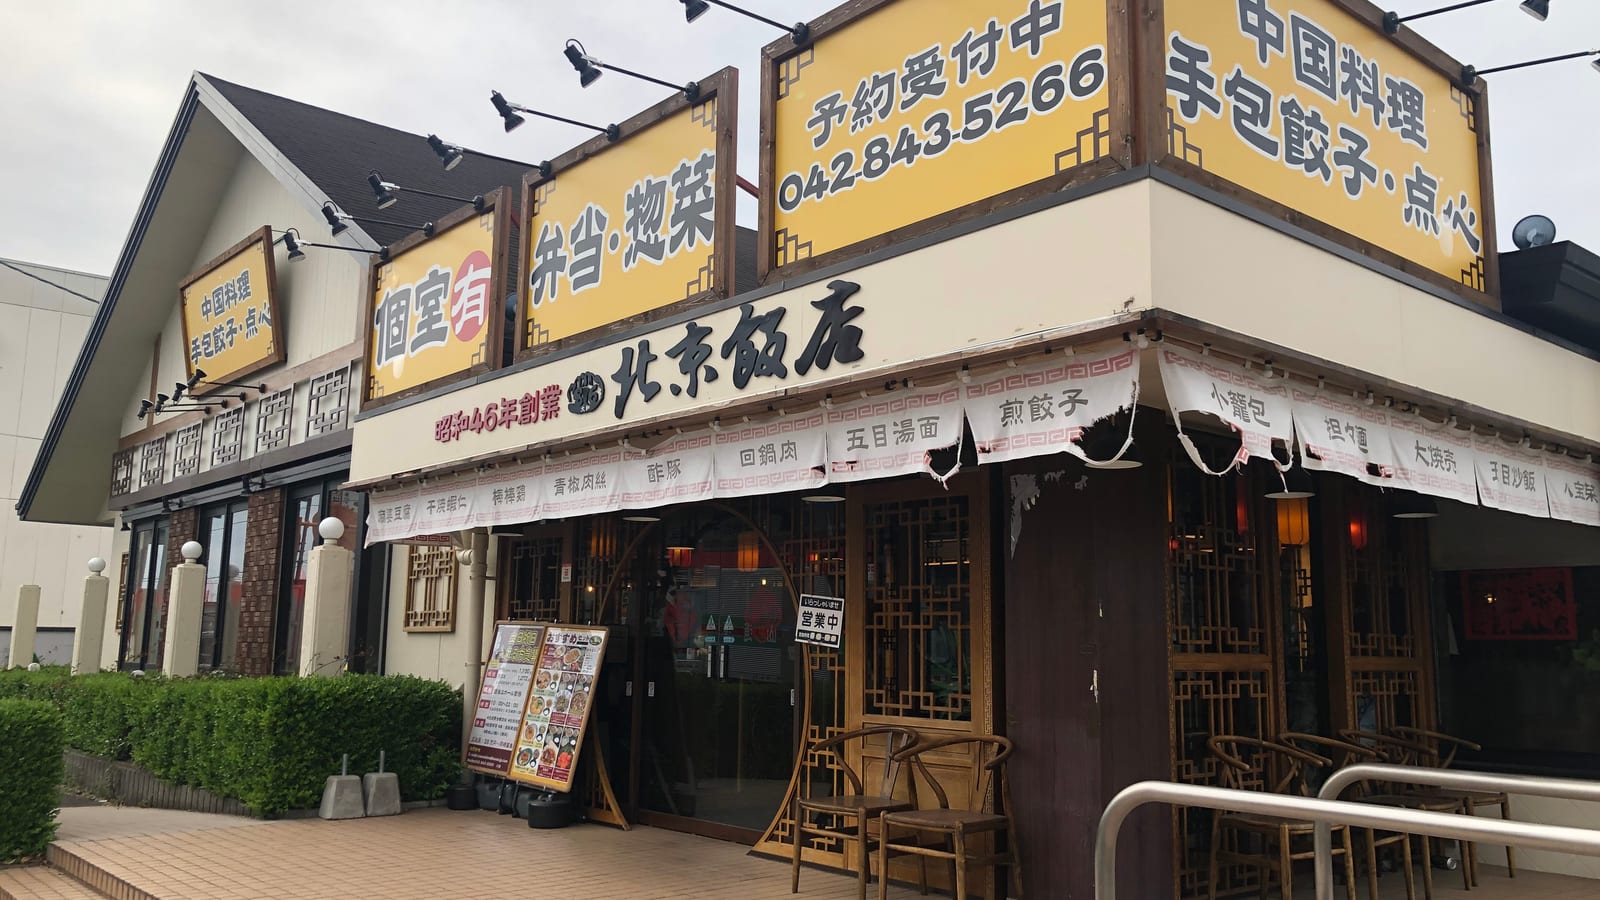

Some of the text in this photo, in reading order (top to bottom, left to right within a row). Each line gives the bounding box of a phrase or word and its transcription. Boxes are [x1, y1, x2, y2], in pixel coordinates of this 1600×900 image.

[807, 0, 1062, 148] 予約受付中
[1238, 0, 1428, 149] 中国料理
[779, 48, 1105, 210] 042-843-5266
[1166, 35, 1481, 254] 手包餃子・点心
[531, 153, 716, 306] 弁当・惣菜
[202, 270, 251, 322] 中国料理
[375, 262, 492, 367] 個室有
[611, 280, 866, 419] 北京飯店
[434, 384, 563, 443] 昭和46年創業
[999, 388, 1090, 429] 煎餃子
[1211, 382, 1271, 429] 小籠包
[740, 439, 799, 468] 回鍋肉
[846, 416, 941, 452] 五目湯面
[554, 471, 607, 497] 青椒肉絲
[646, 458, 682, 483] 酢豚
[801, 610, 839, 631] 営業中
[804, 599, 840, 610] いらっしゃいませ
